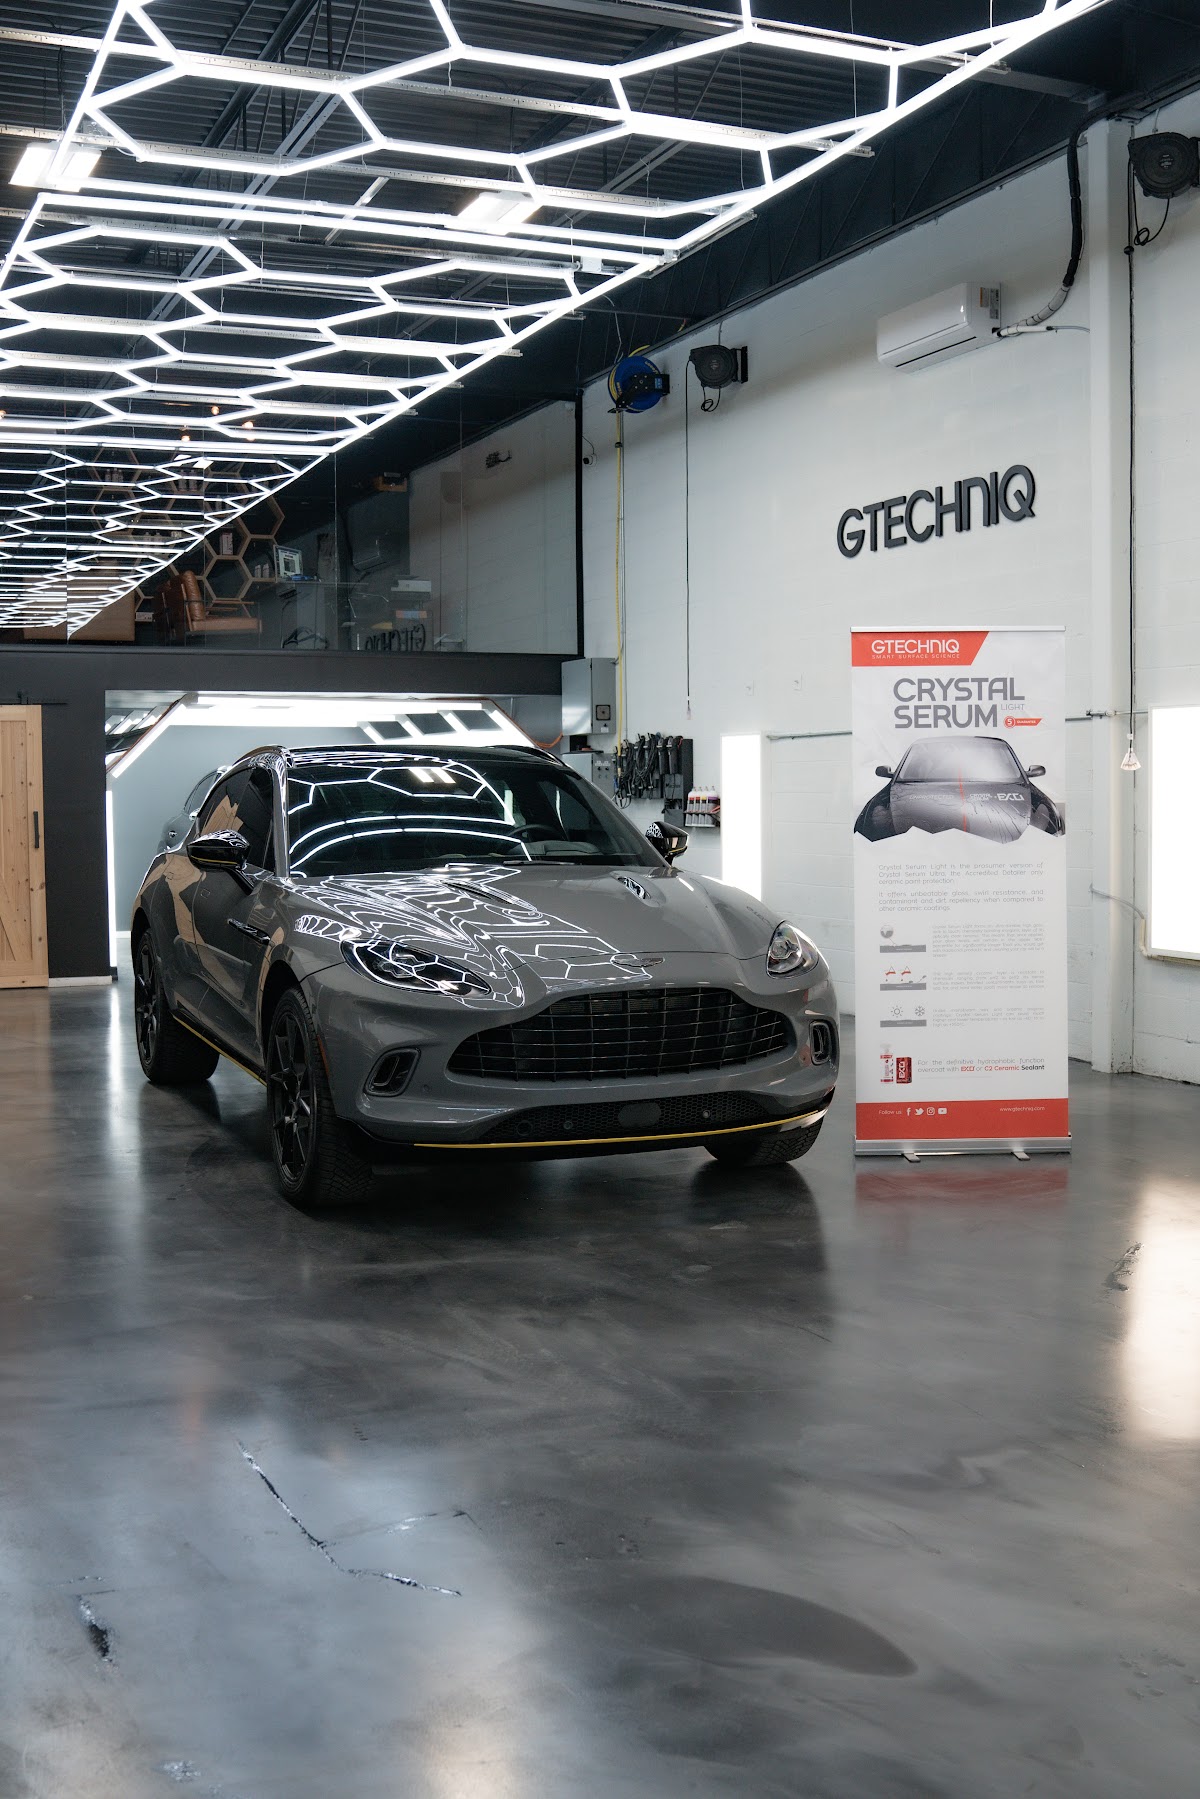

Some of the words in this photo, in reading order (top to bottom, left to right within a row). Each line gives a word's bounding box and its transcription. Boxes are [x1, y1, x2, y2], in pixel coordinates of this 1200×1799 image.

[837, 465, 1036, 558] GTECHNIQ
[871, 639, 960, 653] GTECHNIQ
[893, 677, 1025, 702] CRYSTAL
[894, 704, 997, 728] SERUM
[978, 1058, 1016, 1066] hydrophobic
